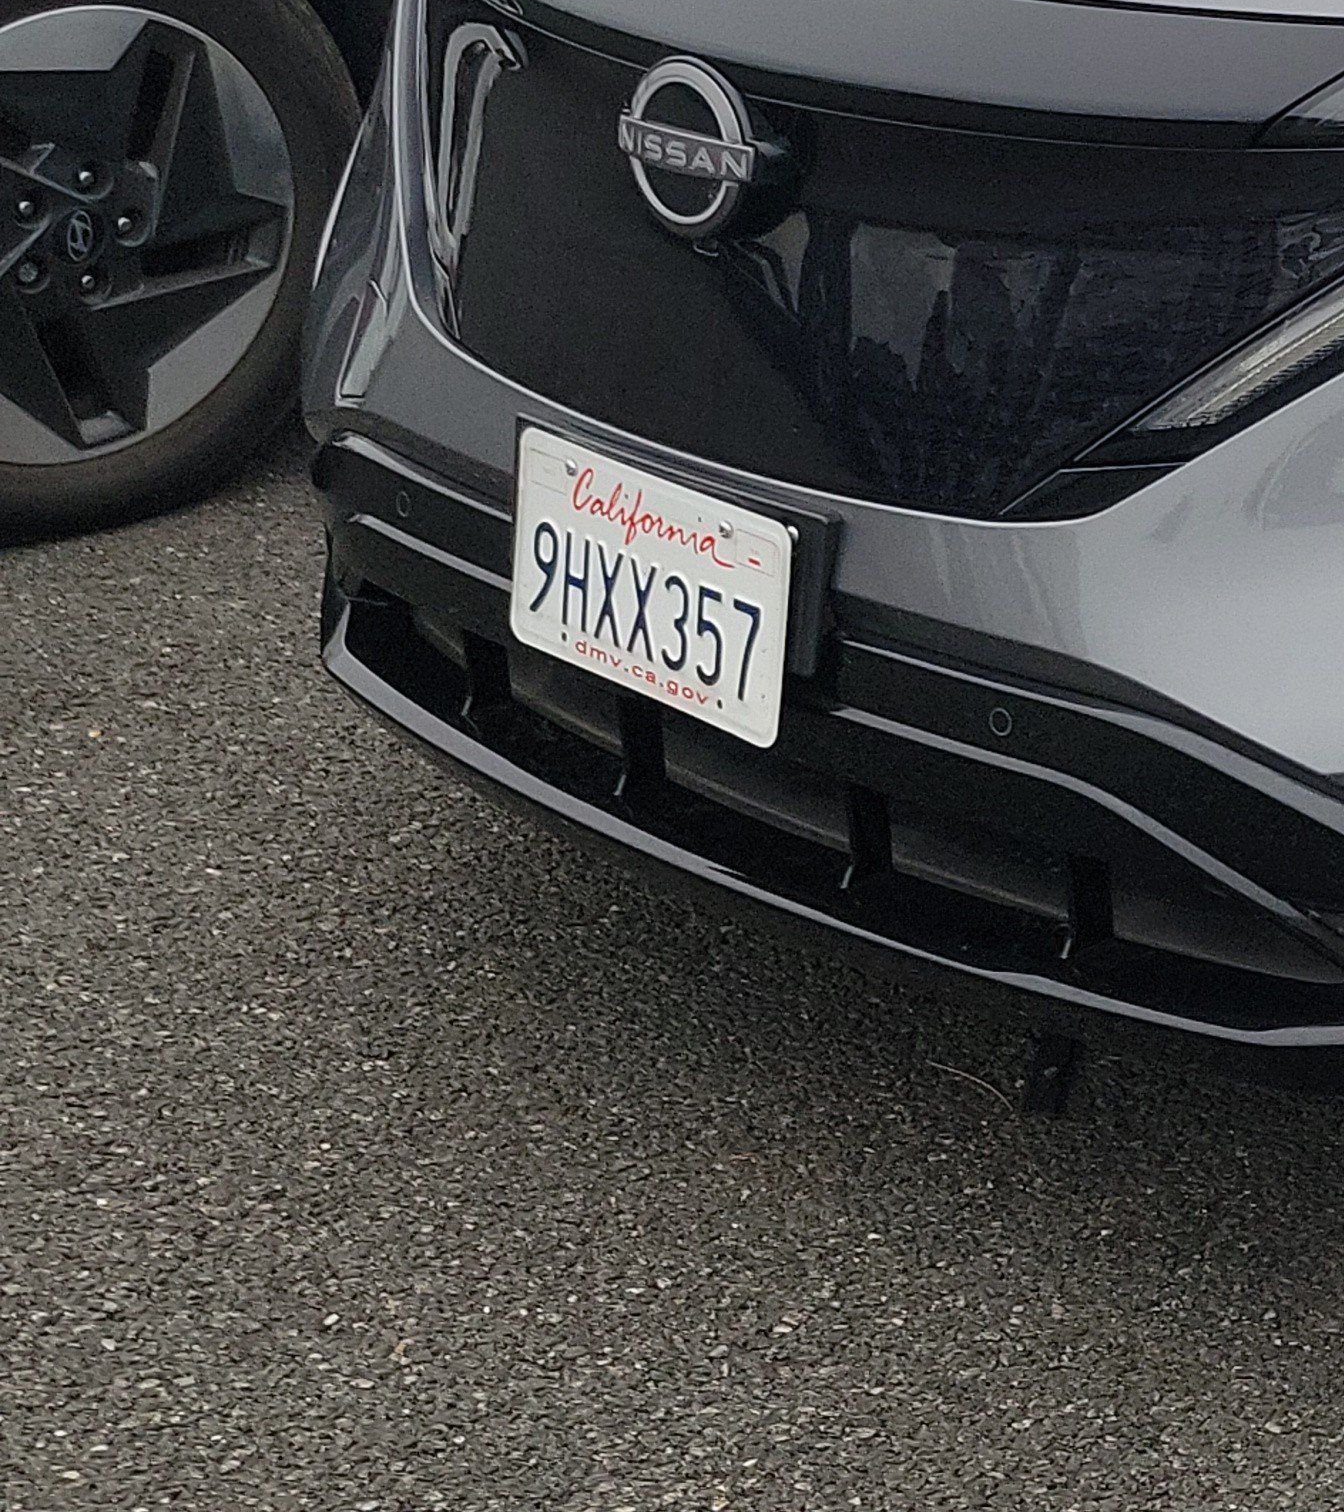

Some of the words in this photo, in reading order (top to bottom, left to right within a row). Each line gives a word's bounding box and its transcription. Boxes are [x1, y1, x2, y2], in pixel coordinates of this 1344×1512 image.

[619, 122, 748, 180] NISSAN
[571, 467, 734, 570] California
[529, 520, 762, 702] 9HXX357
[574, 639, 709, 705] dmv.ca.gov
